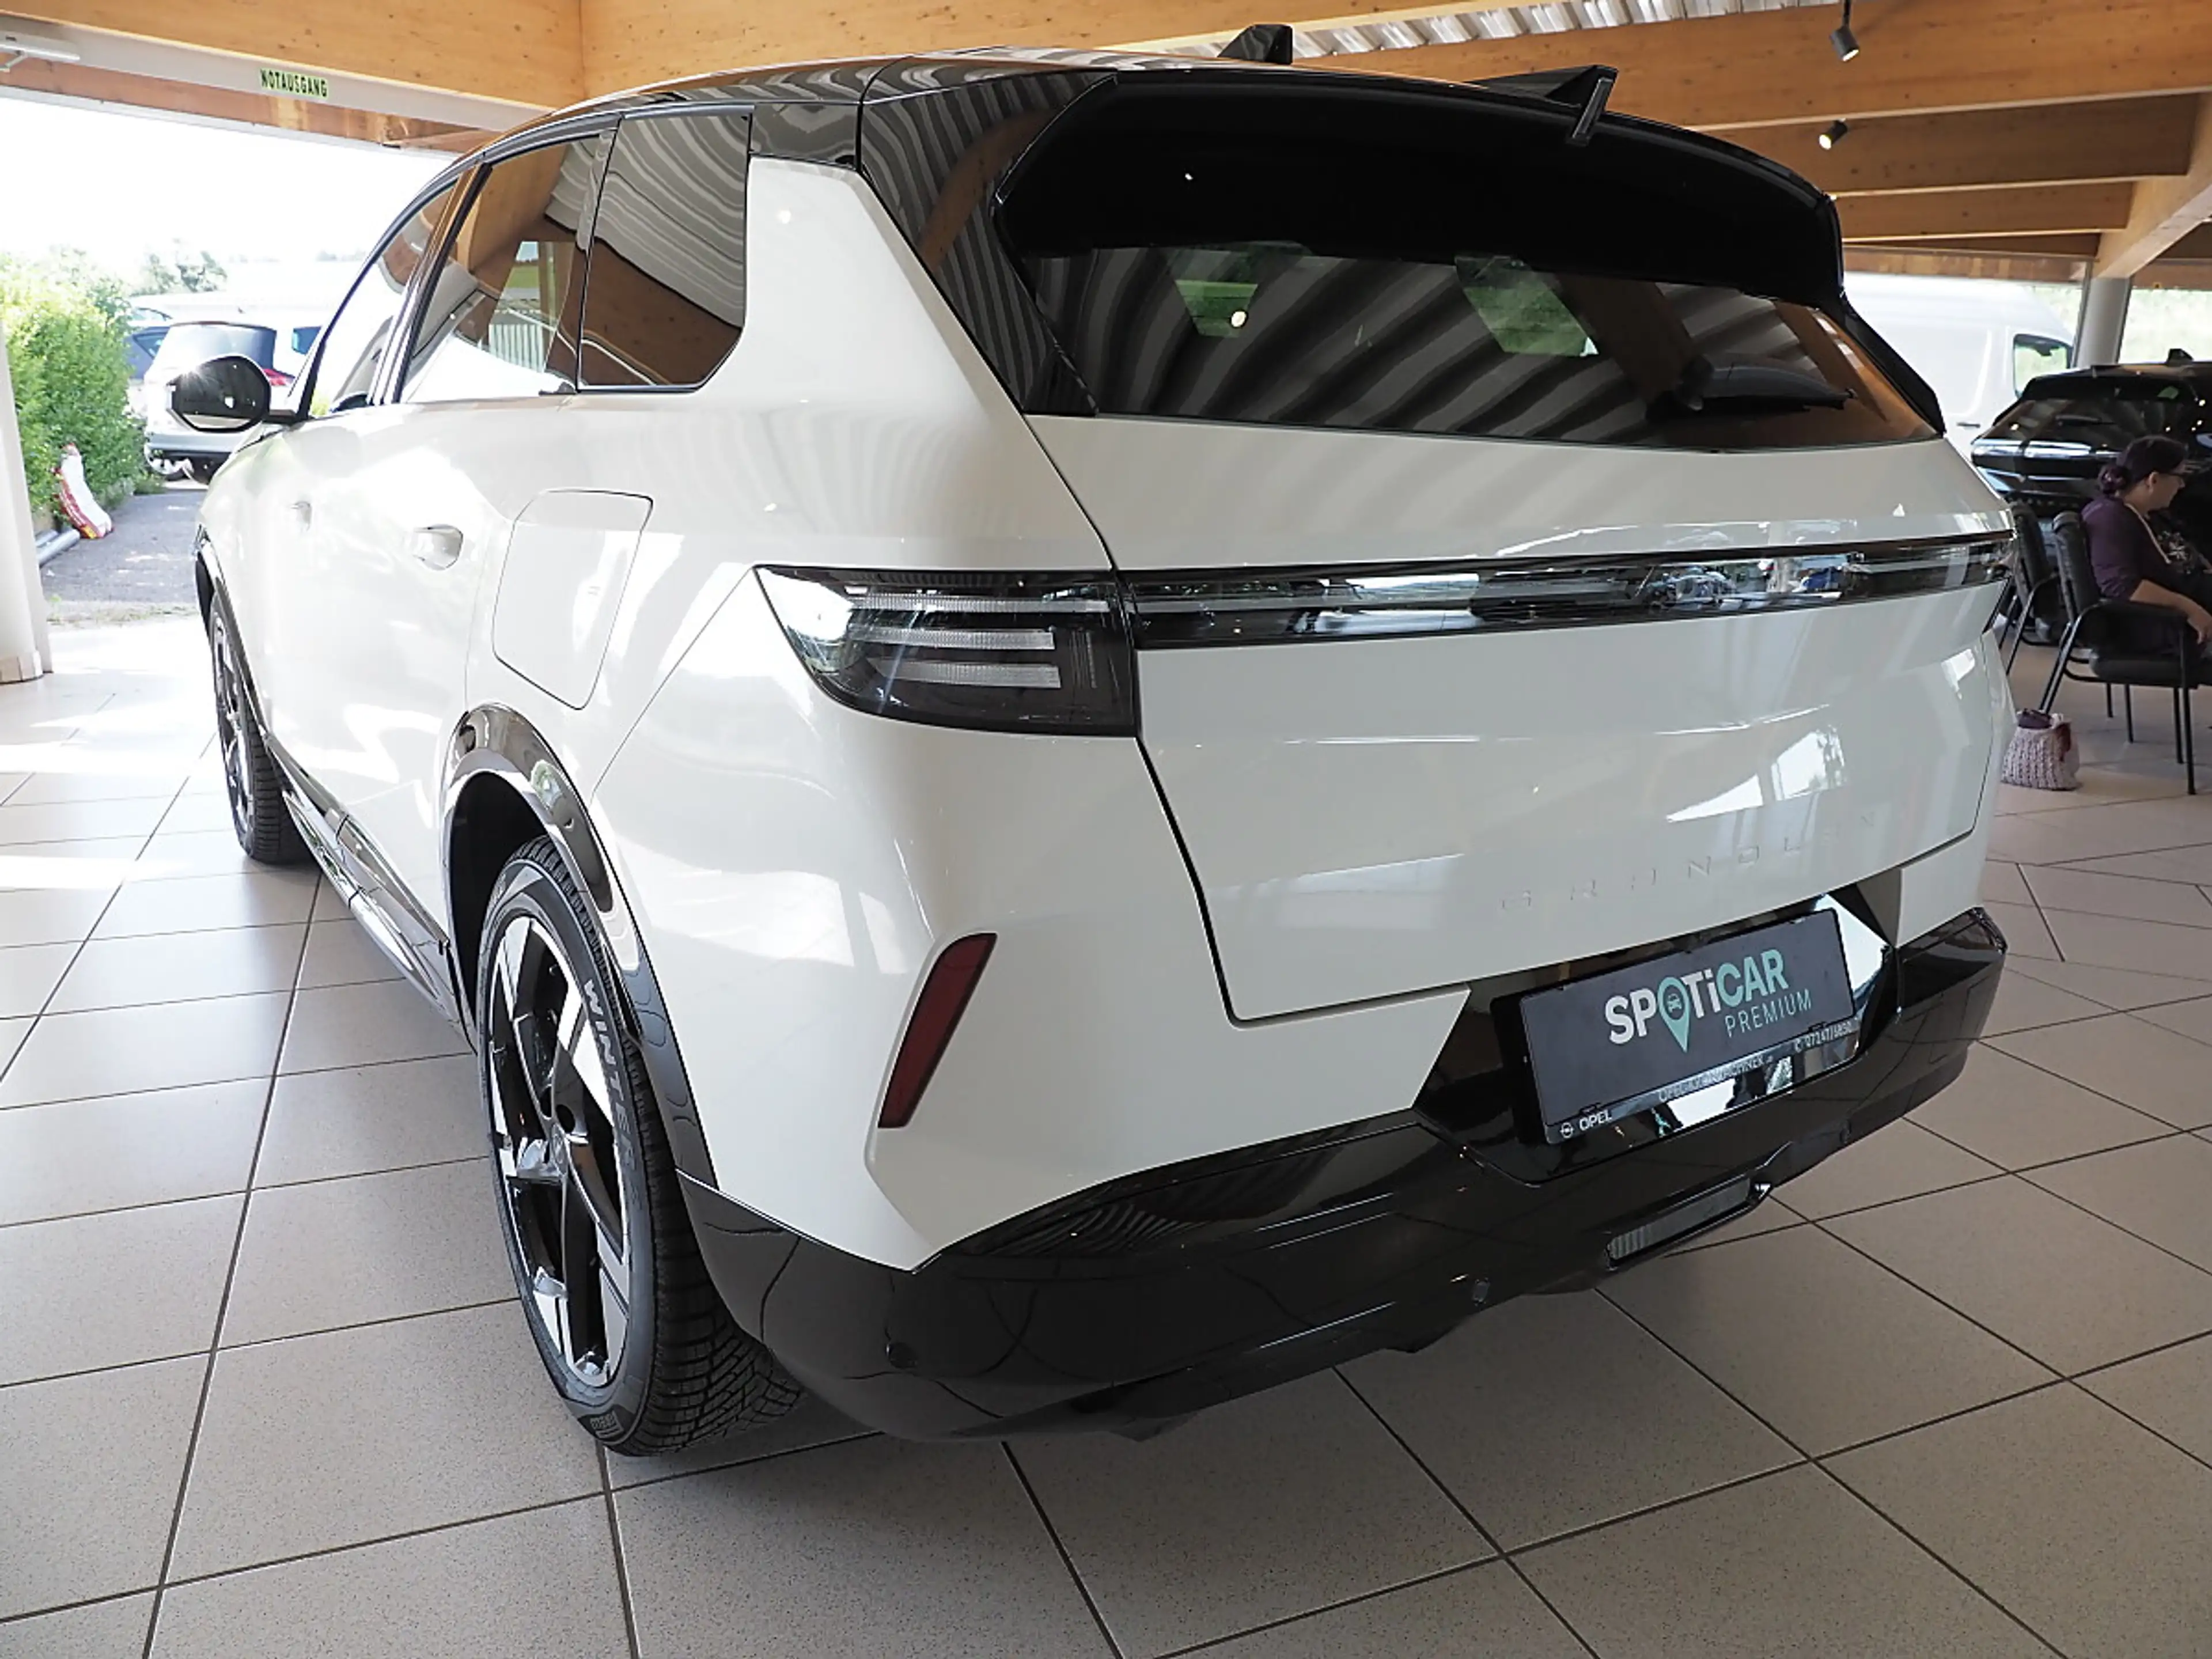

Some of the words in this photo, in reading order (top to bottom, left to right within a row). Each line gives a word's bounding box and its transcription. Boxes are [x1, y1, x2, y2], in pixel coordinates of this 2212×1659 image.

[261, 69, 327, 97] NOTAUSGANG
[1725, 988, 1811, 1038] PREMIUM
[584, 979, 636, 1171] WINTER
[1579, 1109, 1612, 1131] OPEL
